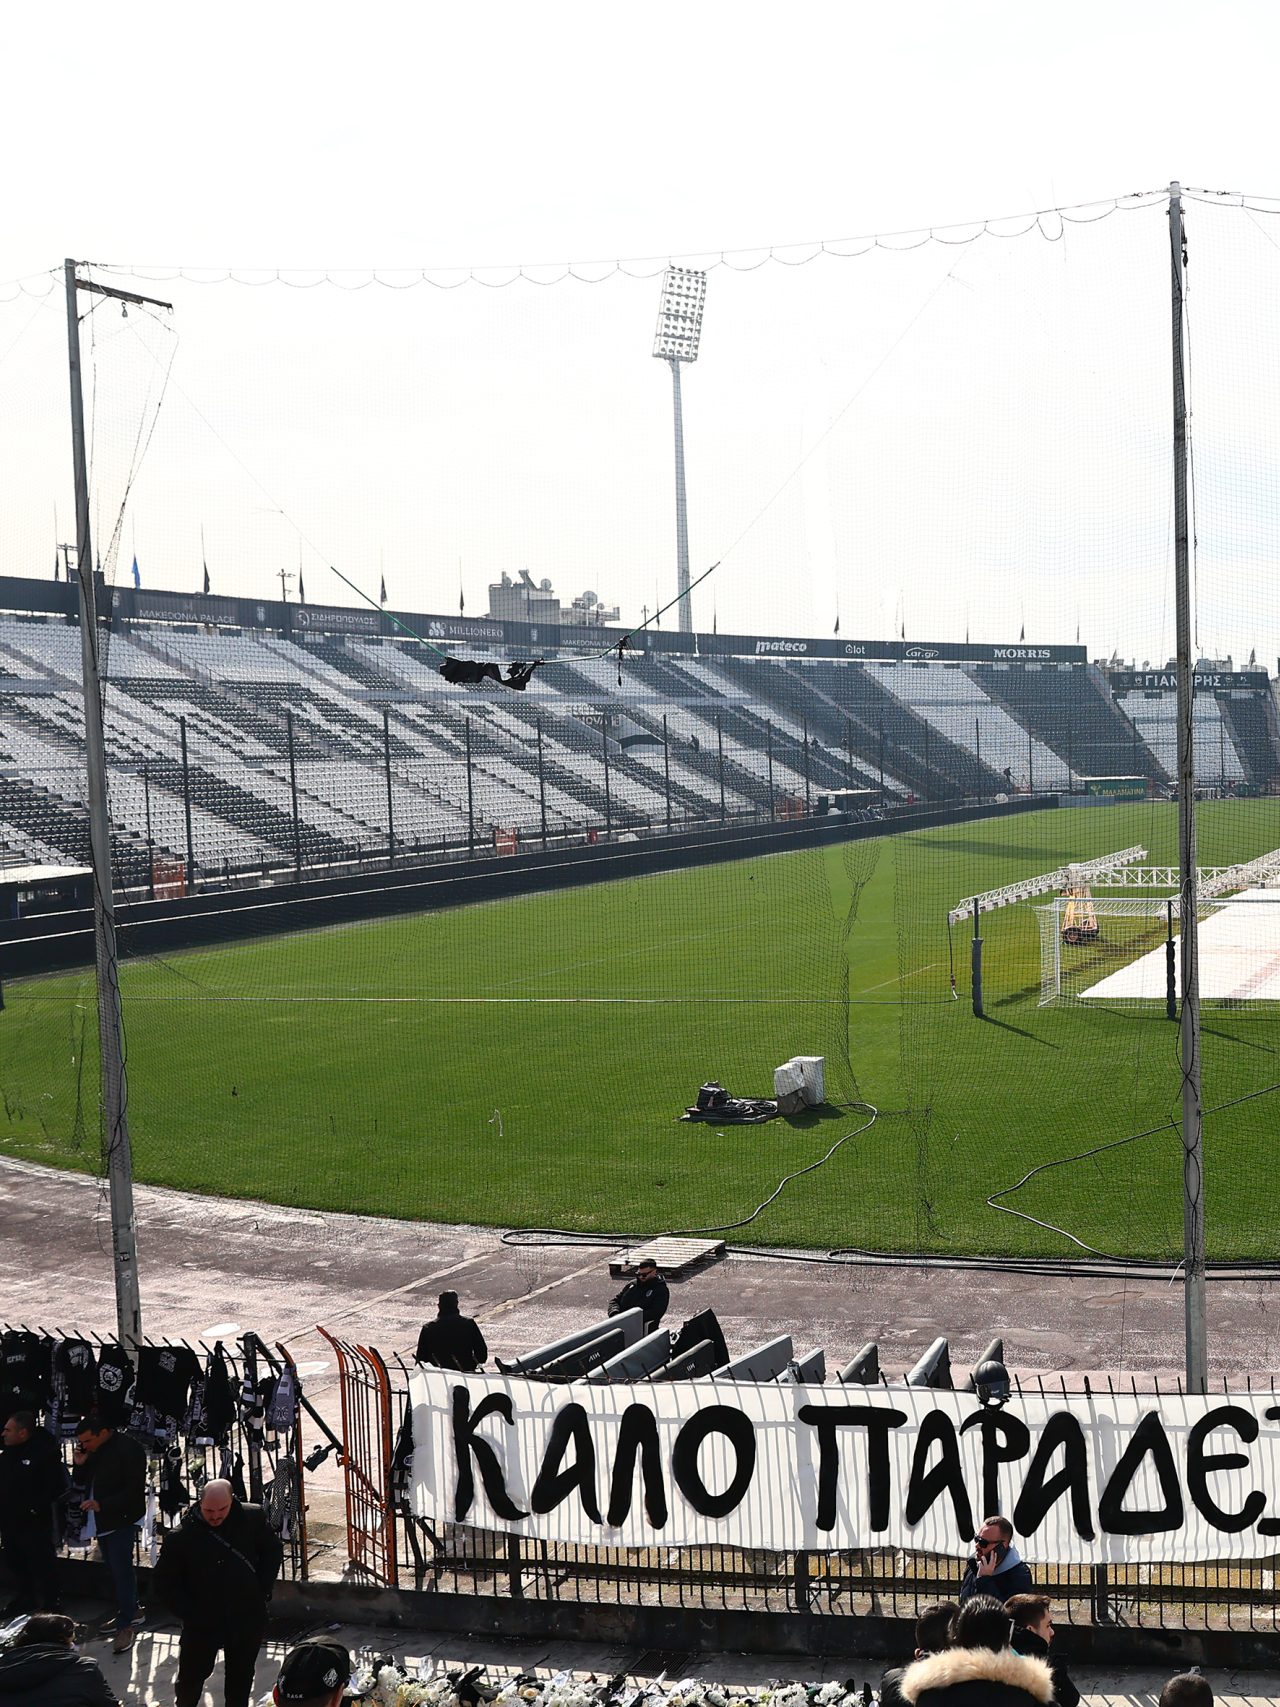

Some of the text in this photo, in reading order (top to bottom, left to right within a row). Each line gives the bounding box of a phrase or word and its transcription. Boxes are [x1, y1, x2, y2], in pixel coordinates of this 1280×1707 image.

[140, 609, 235, 624] MAKEDONIA PALACE
[449, 626, 504, 638] MILLIONERO
[755, 640, 807, 654] mateco
[993, 648, 1051, 659] MORRIS
[452, 1384, 756, 1530] ΚΑΛΟ
